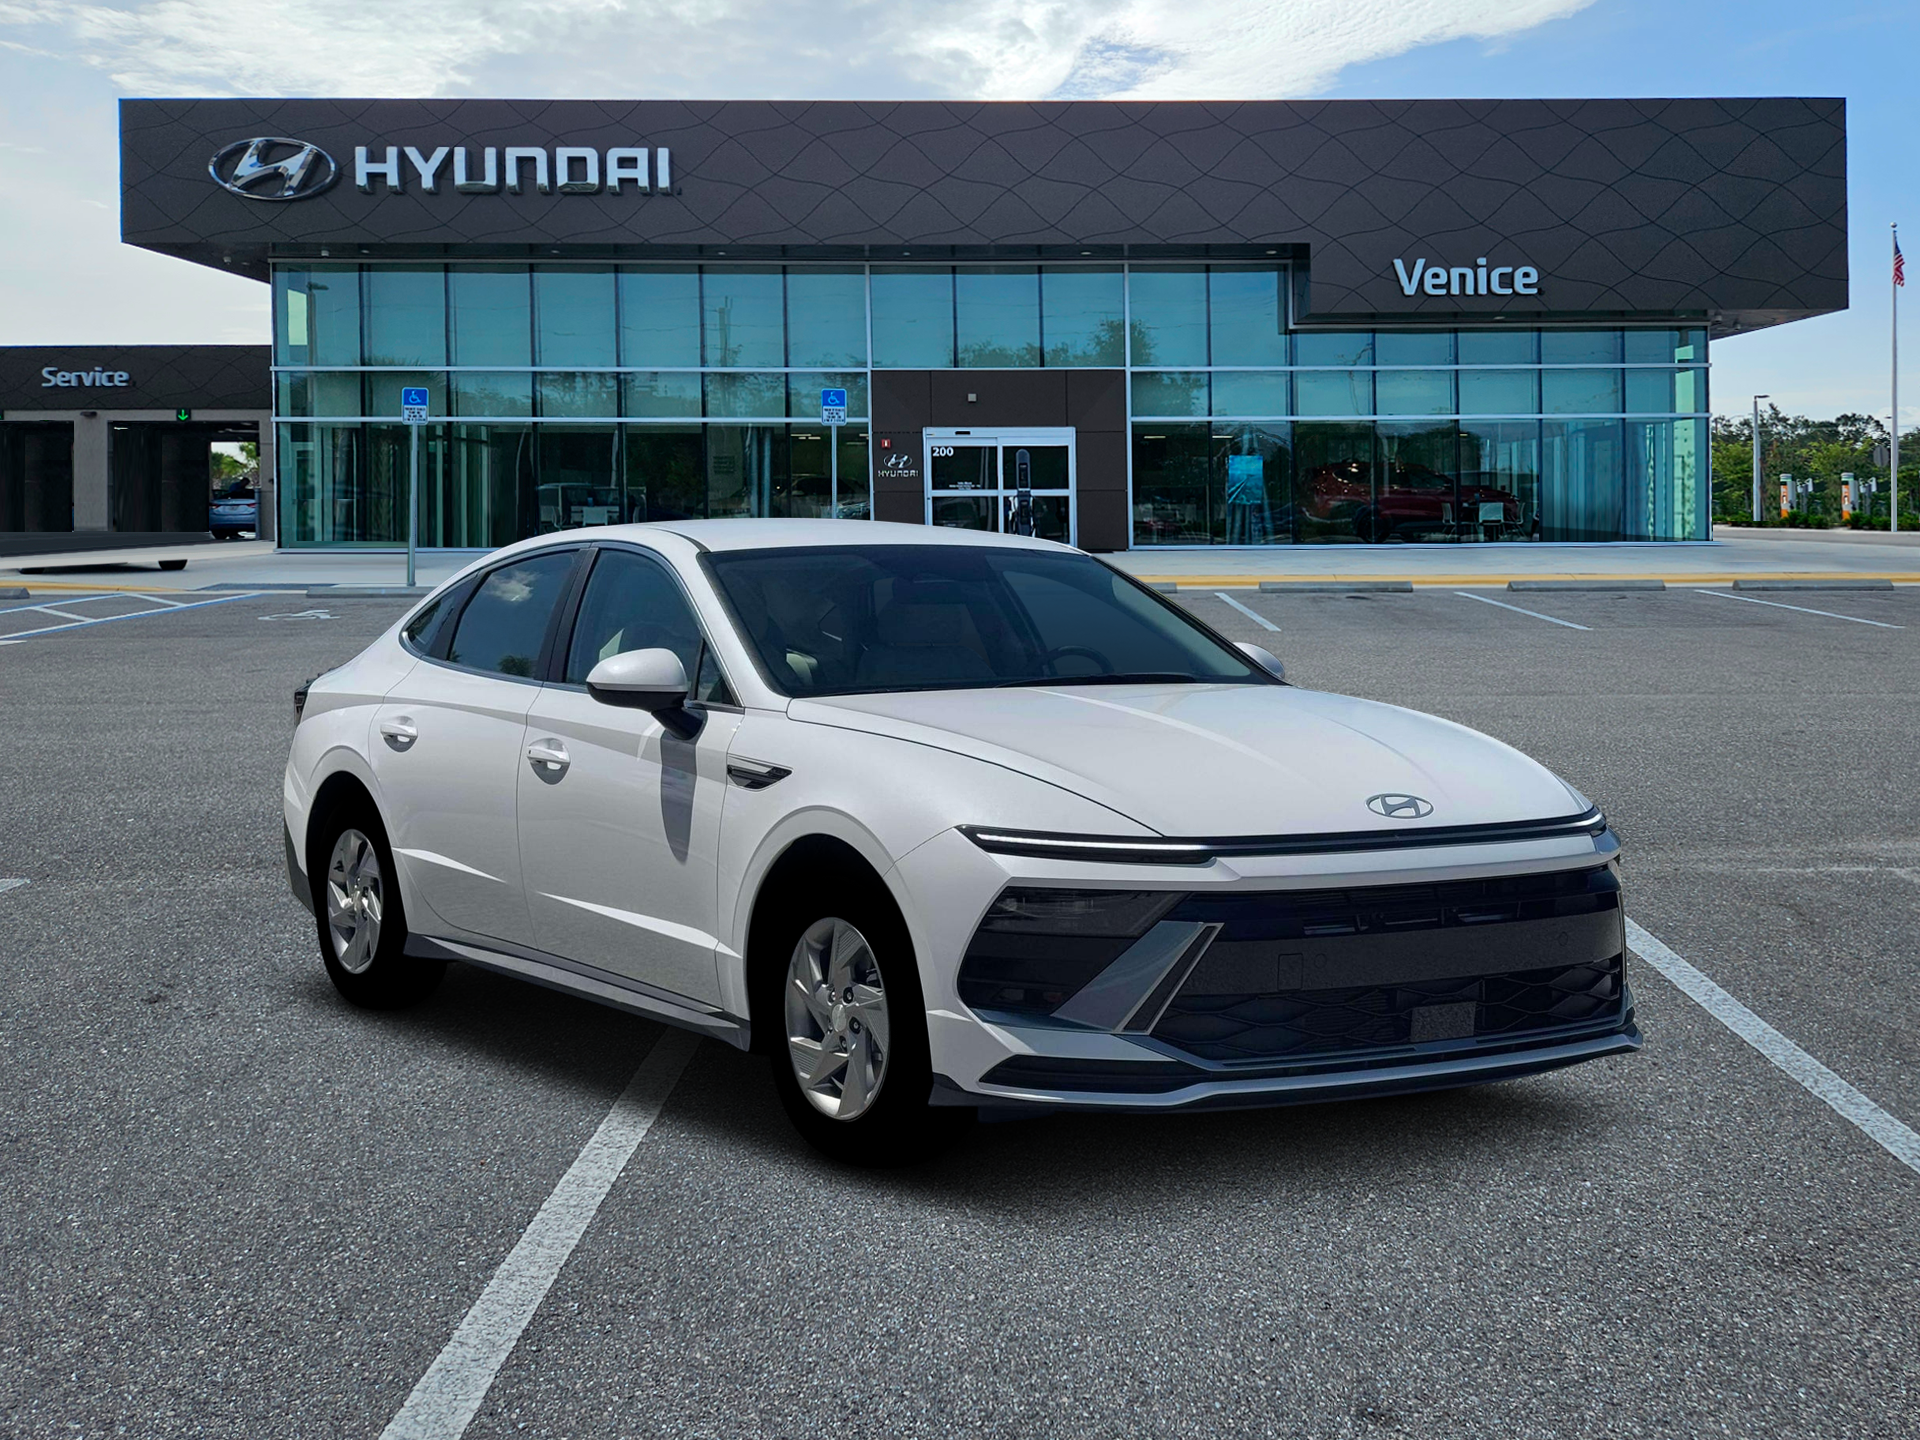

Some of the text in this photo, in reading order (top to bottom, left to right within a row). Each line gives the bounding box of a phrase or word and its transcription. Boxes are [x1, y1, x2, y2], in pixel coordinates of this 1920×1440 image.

[354, 146, 672, 194] HYUNDAI
[1393, 257, 1539, 295] Venice
[41, 367, 129, 387] Service
[932, 447, 954, 457] 200
